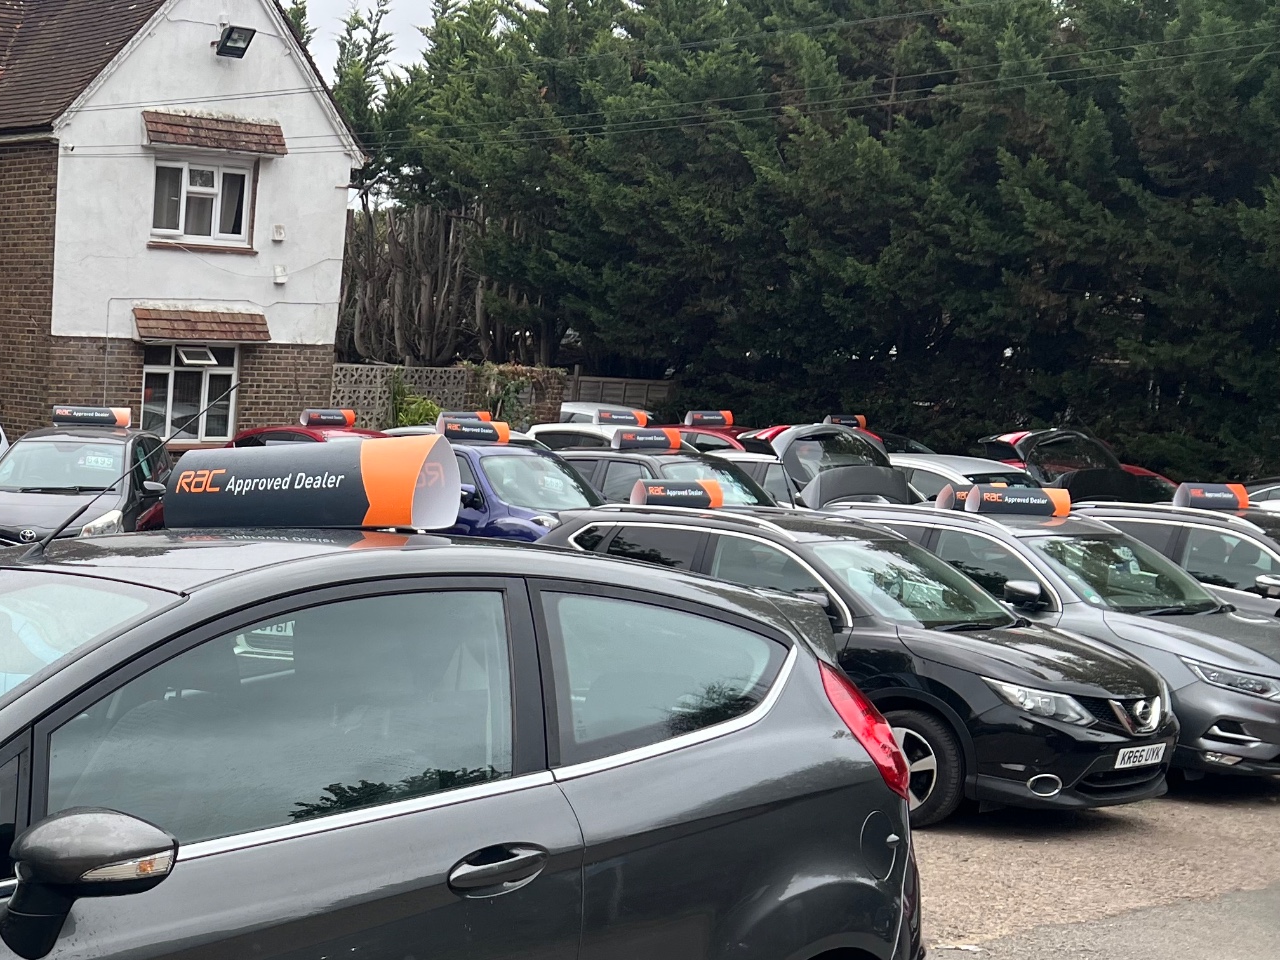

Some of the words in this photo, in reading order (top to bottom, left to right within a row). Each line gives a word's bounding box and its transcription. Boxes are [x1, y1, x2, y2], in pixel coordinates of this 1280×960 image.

[224, 475, 291, 496] Approved
[293, 471, 346, 491] Dealer
[666, 489, 689, 497] Approved
[1004, 496, 1030, 504] Approved
[1029, 497, 1048, 505] Dealer
[1119, 748, 1146, 766] KR66
[1144, 745, 1163, 762] UYK
